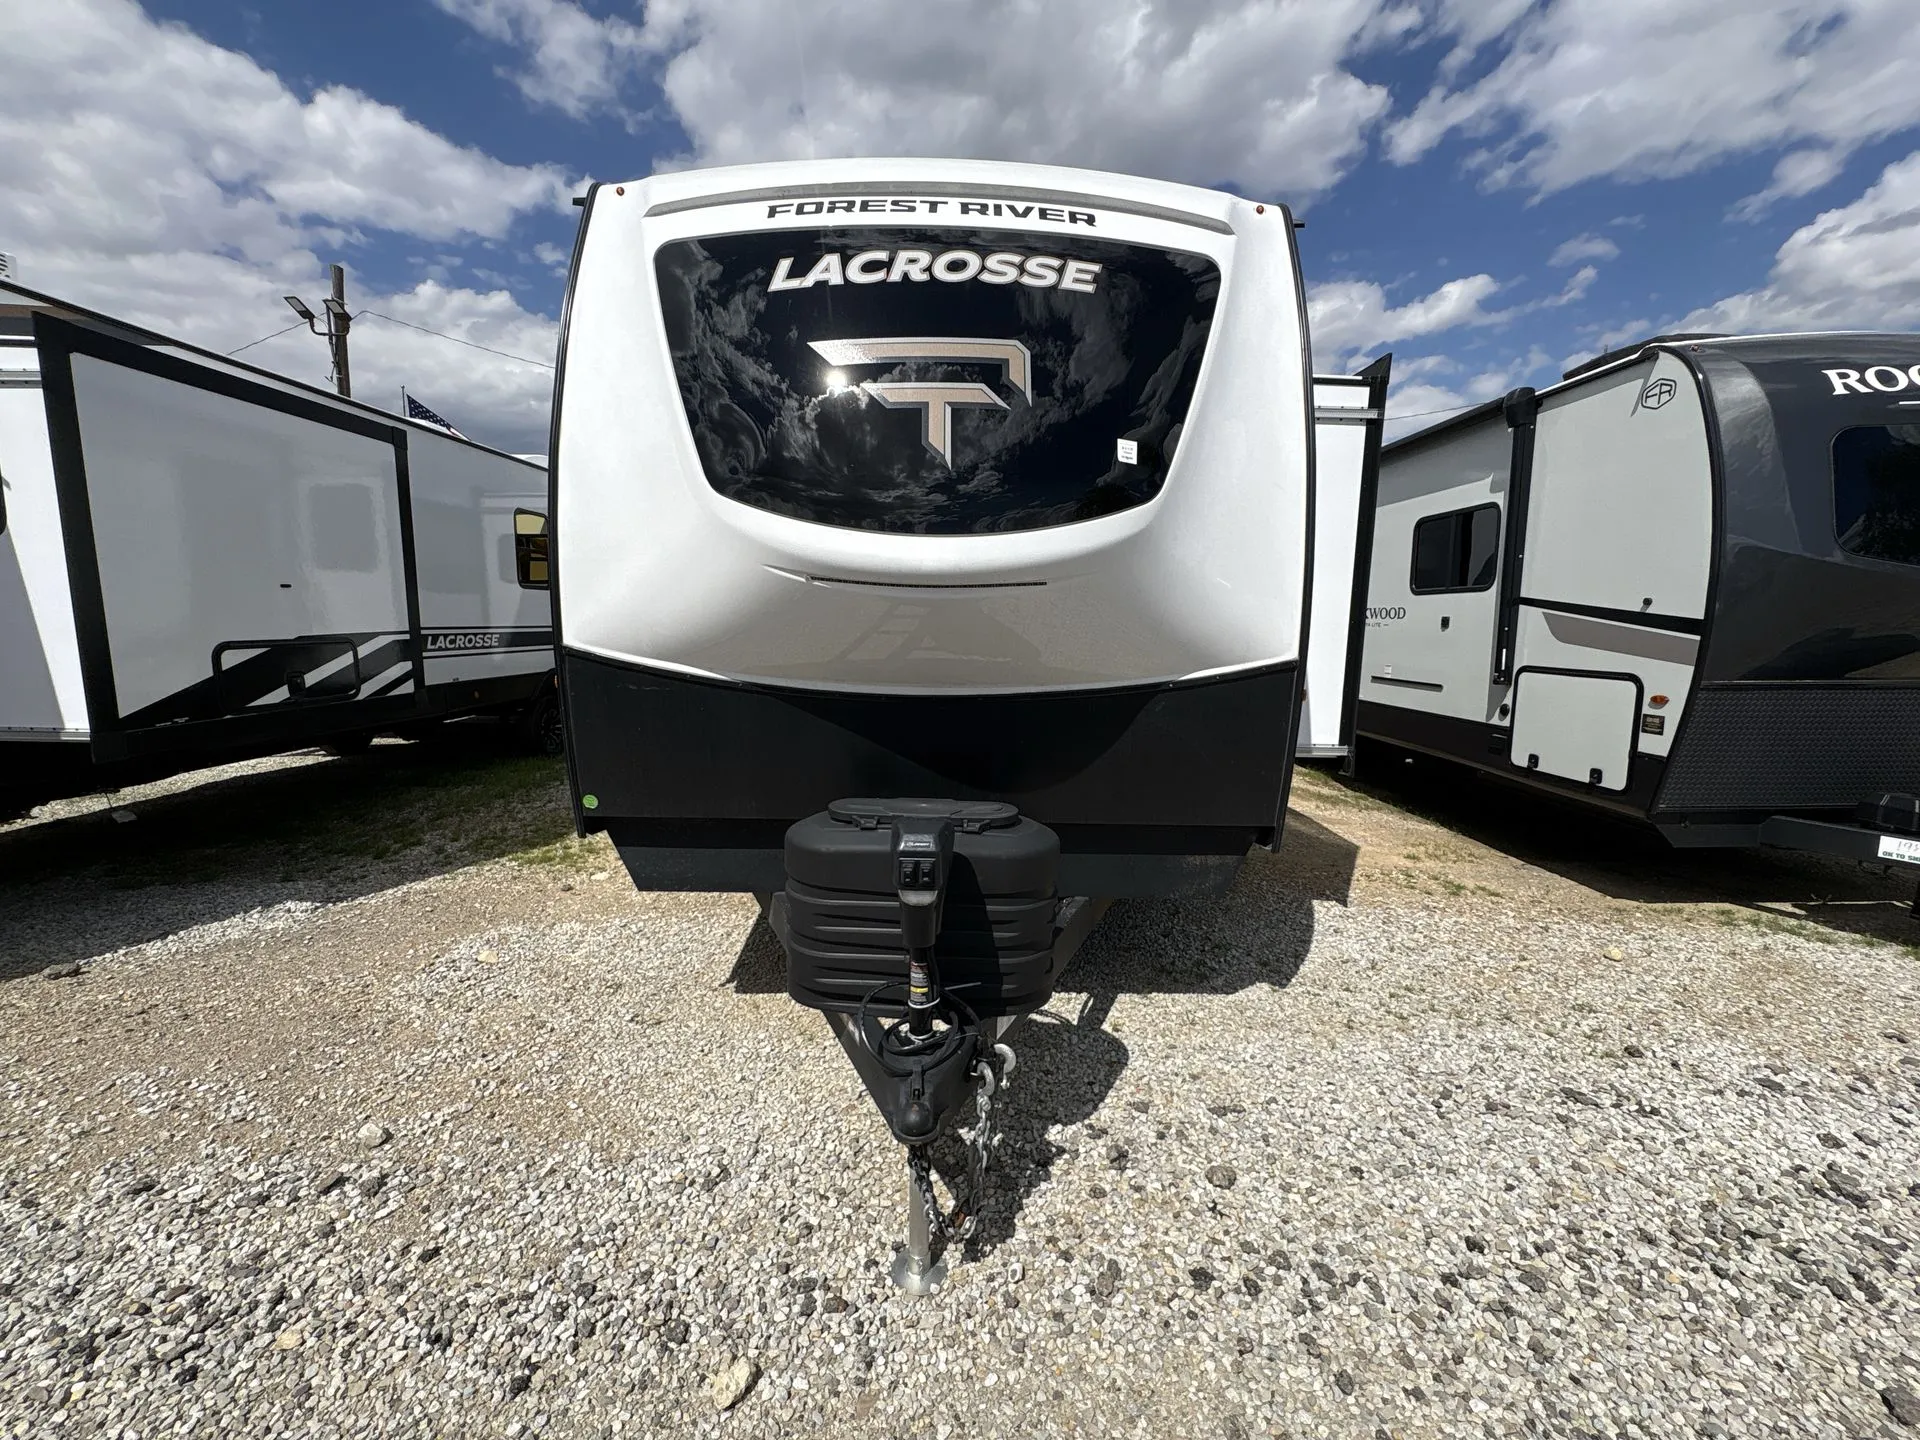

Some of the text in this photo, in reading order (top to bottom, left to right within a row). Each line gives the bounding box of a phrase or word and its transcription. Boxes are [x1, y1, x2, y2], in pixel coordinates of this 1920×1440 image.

[767, 199, 1097, 227] FOREST RIVER
[767, 249, 1102, 294] LACROSSE
[427, 634, 500, 649] LACROSSE
